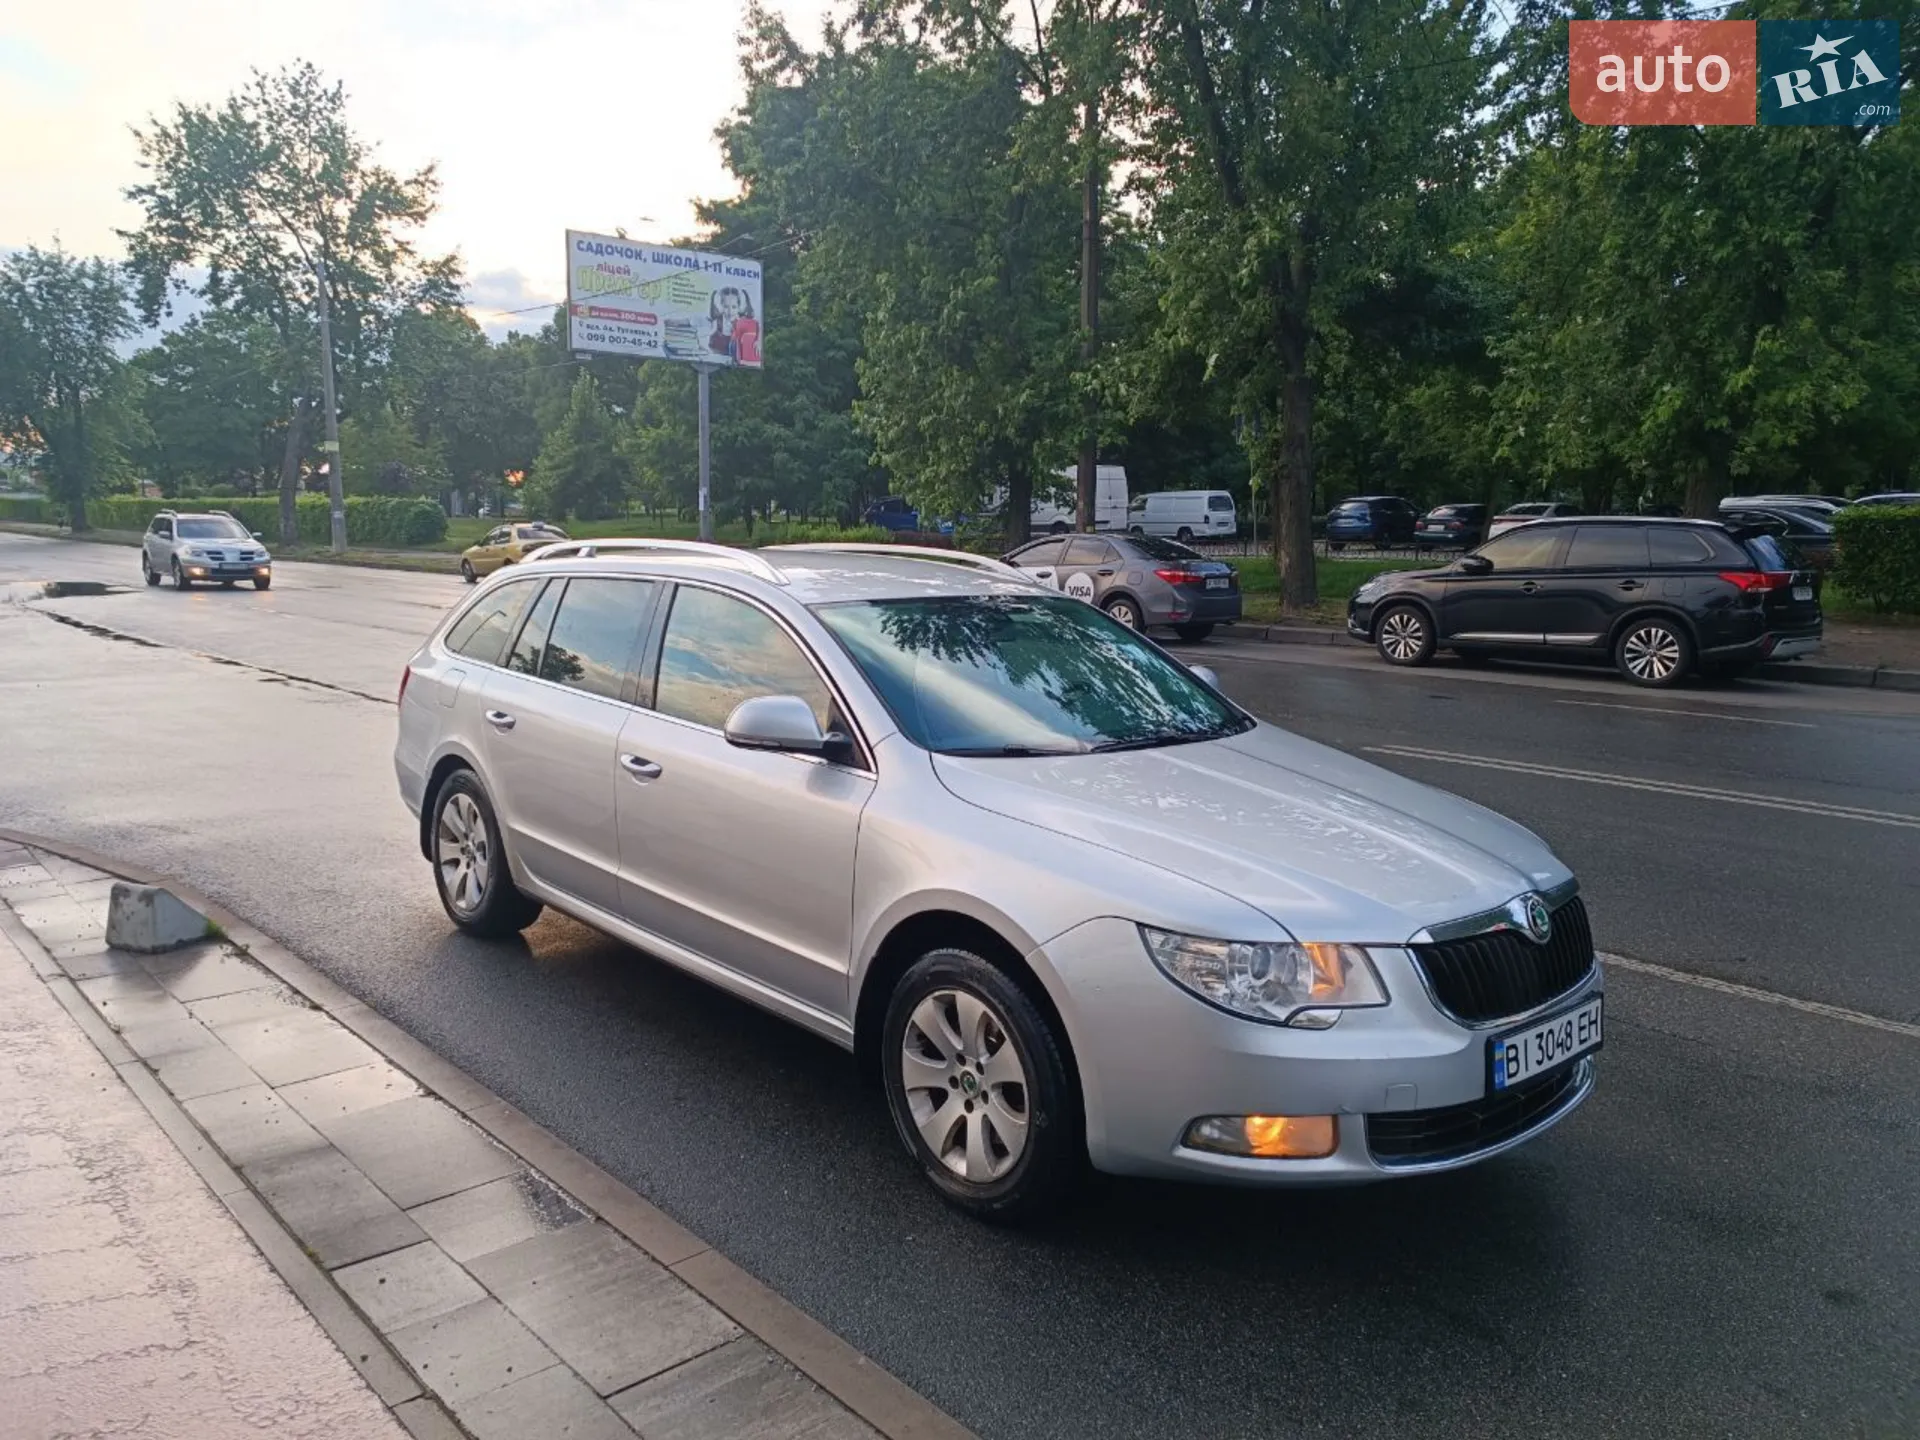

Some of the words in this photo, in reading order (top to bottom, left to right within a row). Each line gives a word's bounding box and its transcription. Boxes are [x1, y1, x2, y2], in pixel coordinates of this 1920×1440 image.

[576, 239, 647, 263] САДОЧОК,
[652, 252, 700, 270] ШКОЛА
[725, 266, 760, 280] класи
[596, 262, 631, 276] ліцей
[586, 332, 605, 343] 099
[1067, 585, 1091, 597] VISA
[1506, 1039, 1529, 1079] BI
[1535, 1020, 1573, 1066] 3048
[1578, 1007, 1599, 1046] EH
